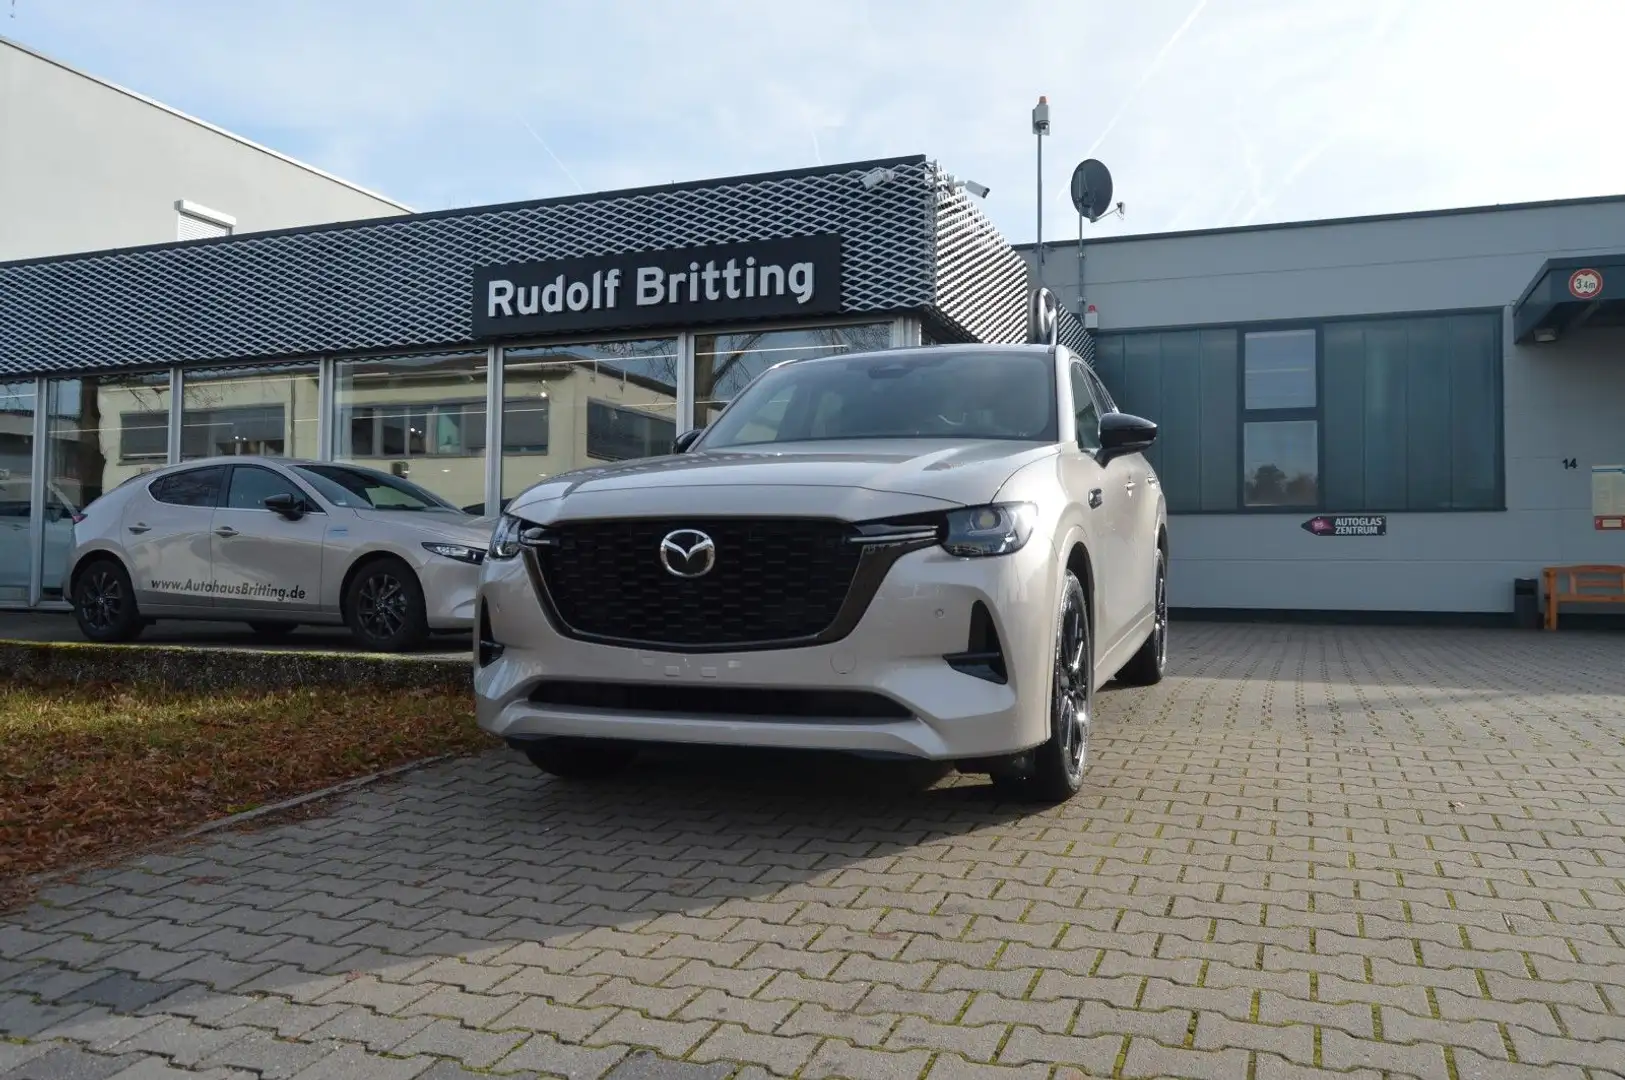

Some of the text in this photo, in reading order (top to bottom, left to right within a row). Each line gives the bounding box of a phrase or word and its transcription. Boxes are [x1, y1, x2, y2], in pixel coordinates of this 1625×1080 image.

[488, 256, 814, 317] Rudolf Britting
[1562, 458, 1578, 469] 14
[1335, 517, 1382, 526] AUTOGLAS
[1335, 526, 1378, 535] ZENTRUM
[151, 578, 306, 601] www.AutohausBritting.de
